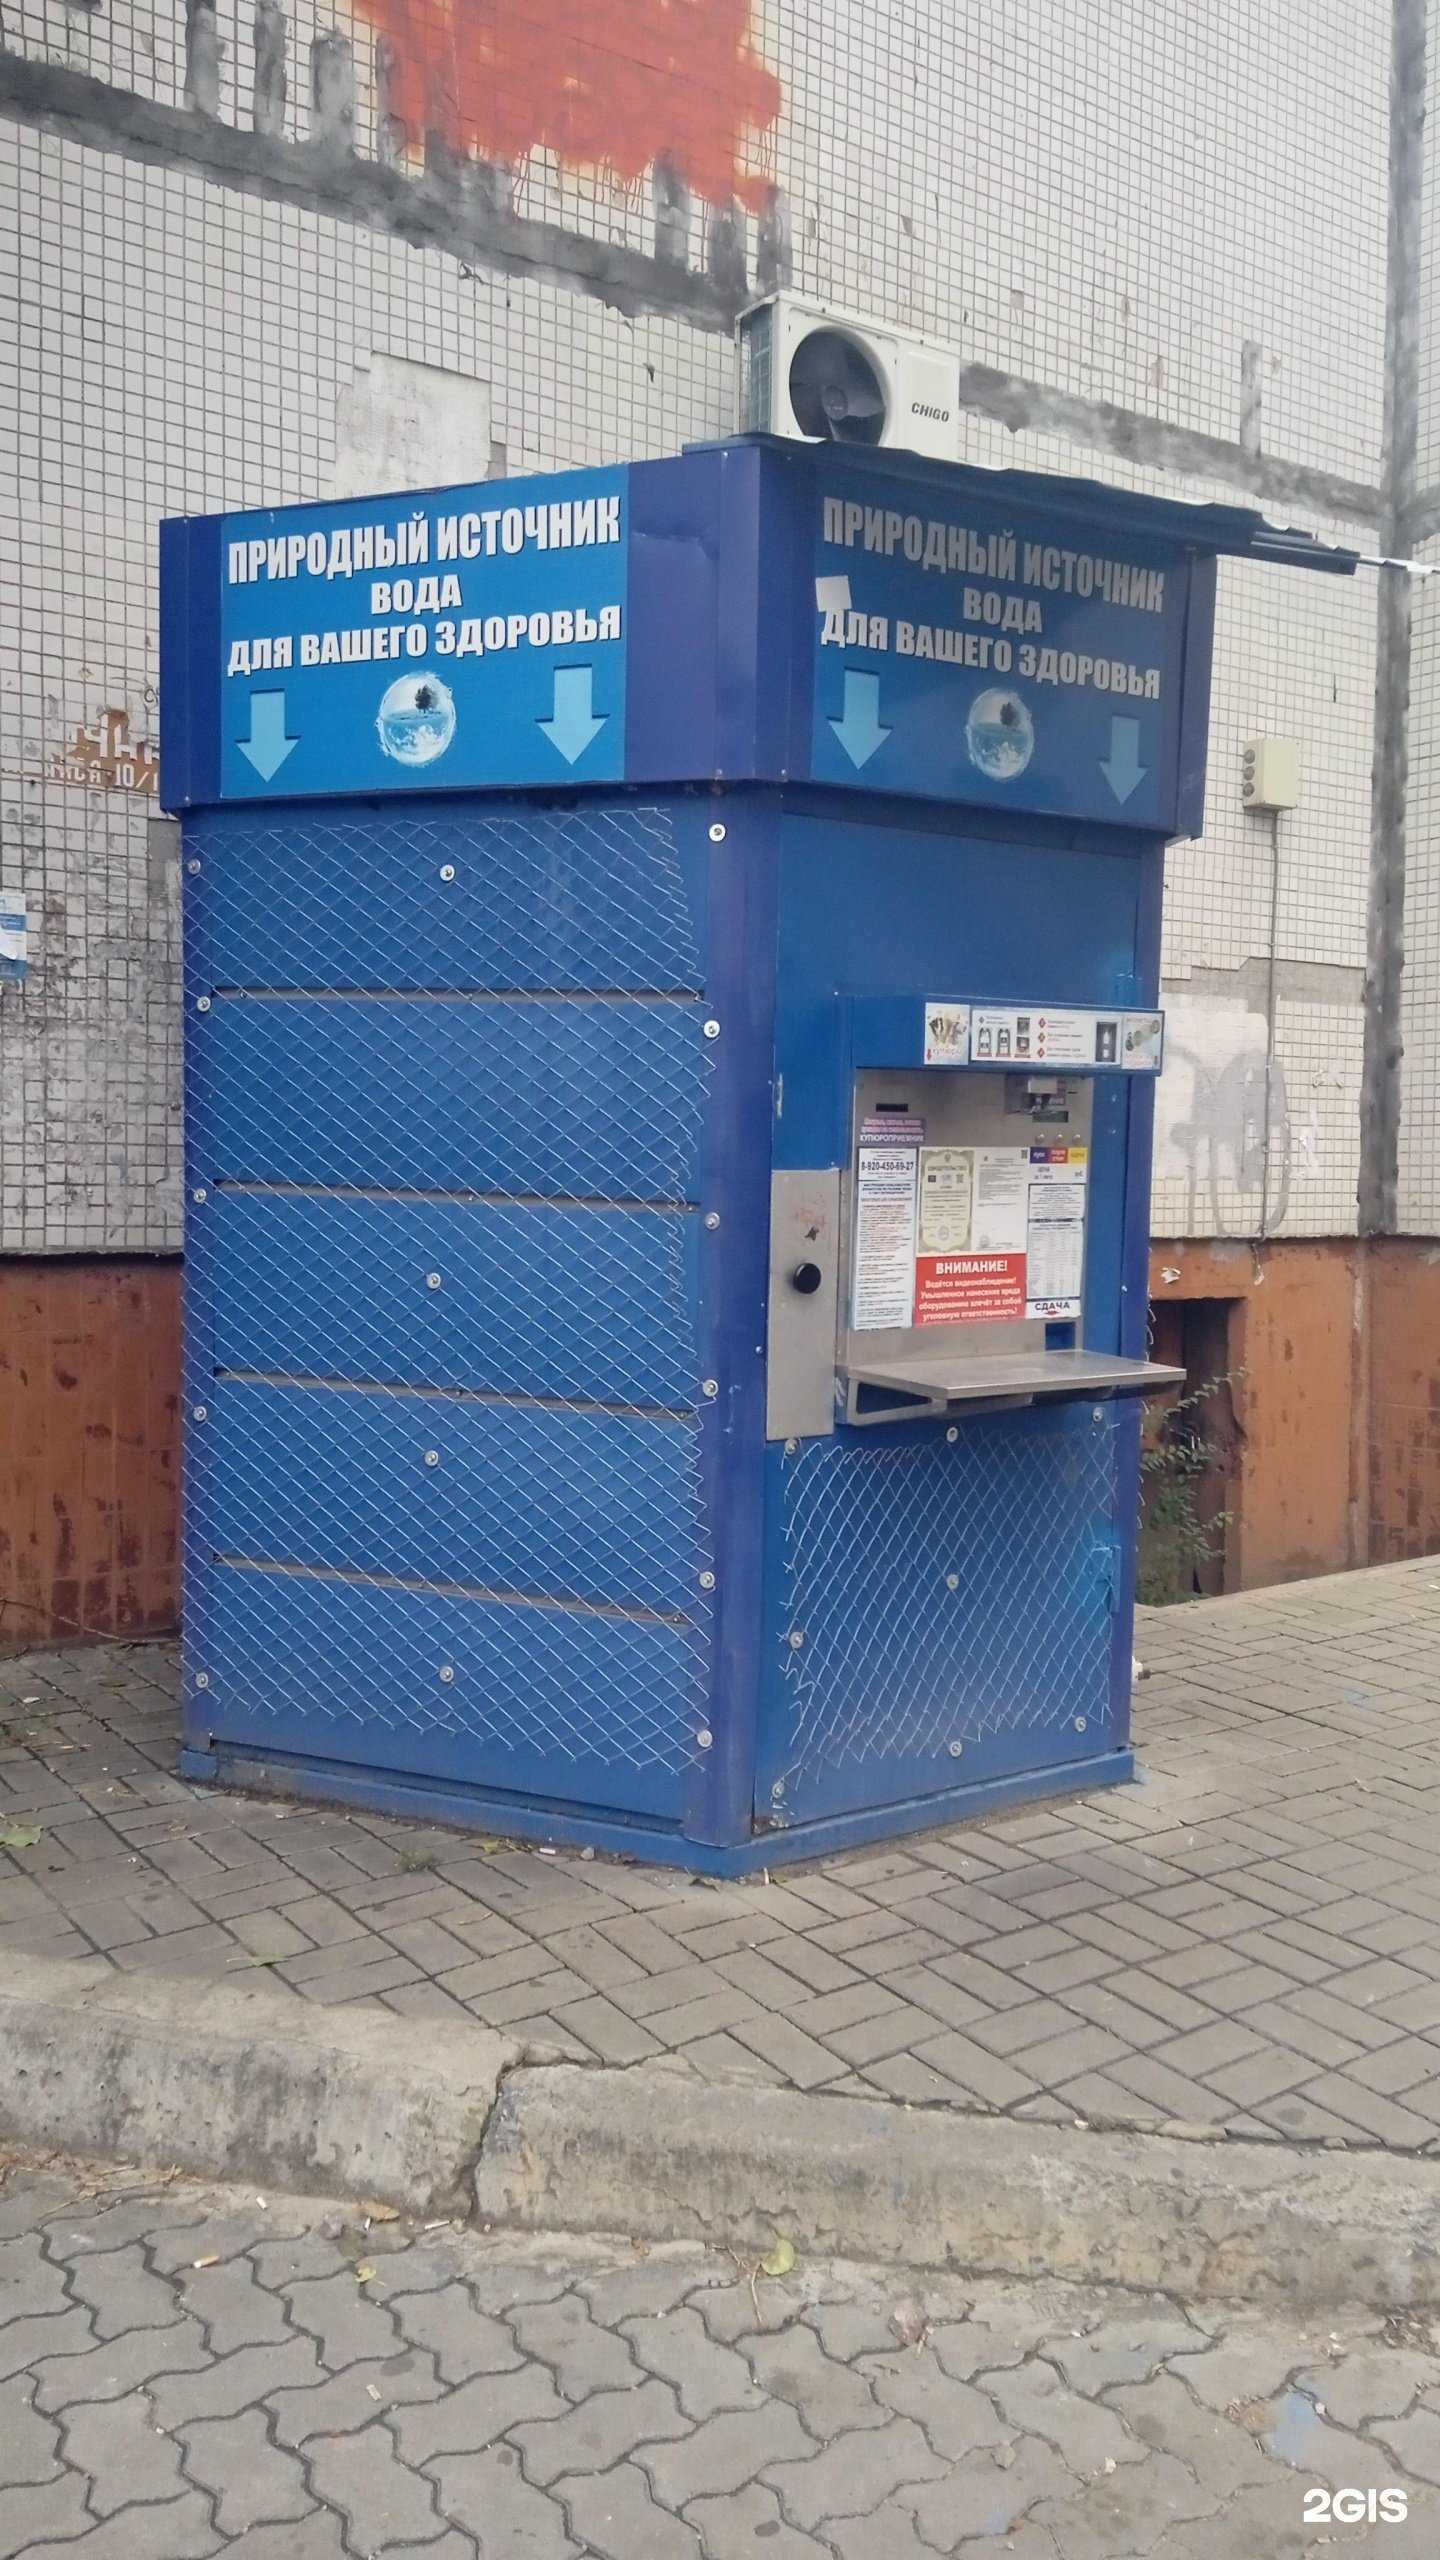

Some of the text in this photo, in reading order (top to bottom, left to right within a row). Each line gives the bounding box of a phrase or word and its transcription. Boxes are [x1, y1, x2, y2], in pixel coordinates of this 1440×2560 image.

[911, 401, 950, 423] CHIGO
[228, 495, 621, 585] ПРИРОДНЫЙ ИСТОЧНИК
[823, 496, 1165, 613] ПРИРОДНЫЙ ИСТОЧНИК
[370, 573, 463, 616] ВОДА
[963, 587, 1043, 635] ВОДА
[226, 604, 622, 678] ДЛЯ ВАШЕГО ЗДОРОВЬЯ
[820, 609, 1161, 700] ДЛЯ ВАШЕГО ЗДОРОВЬЯ
[935, 1259, 1008, 1275] ВНИМАНИЕ!
[1034, 1301, 1070, 1311] СДАЧА
